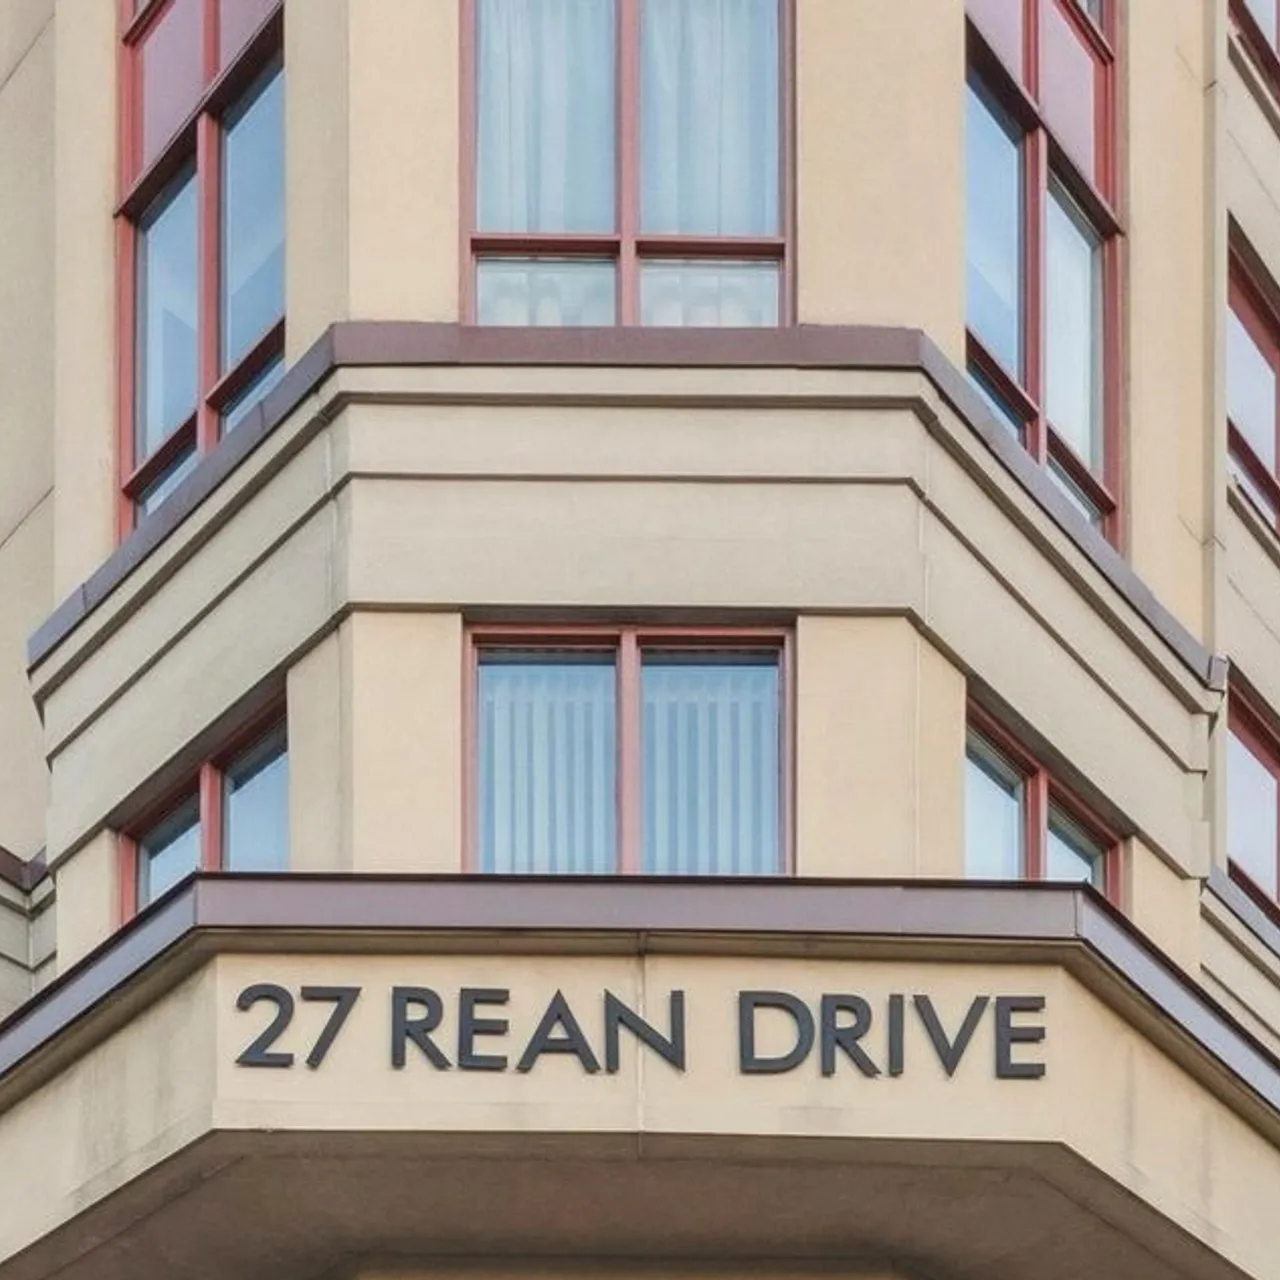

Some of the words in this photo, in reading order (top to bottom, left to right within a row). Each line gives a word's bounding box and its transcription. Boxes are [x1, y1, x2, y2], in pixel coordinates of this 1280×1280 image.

[234, 983, 363, 1070] 27
[390, 986, 688, 1074] REAN
[738, 990, 1047, 1080] DRIVE
